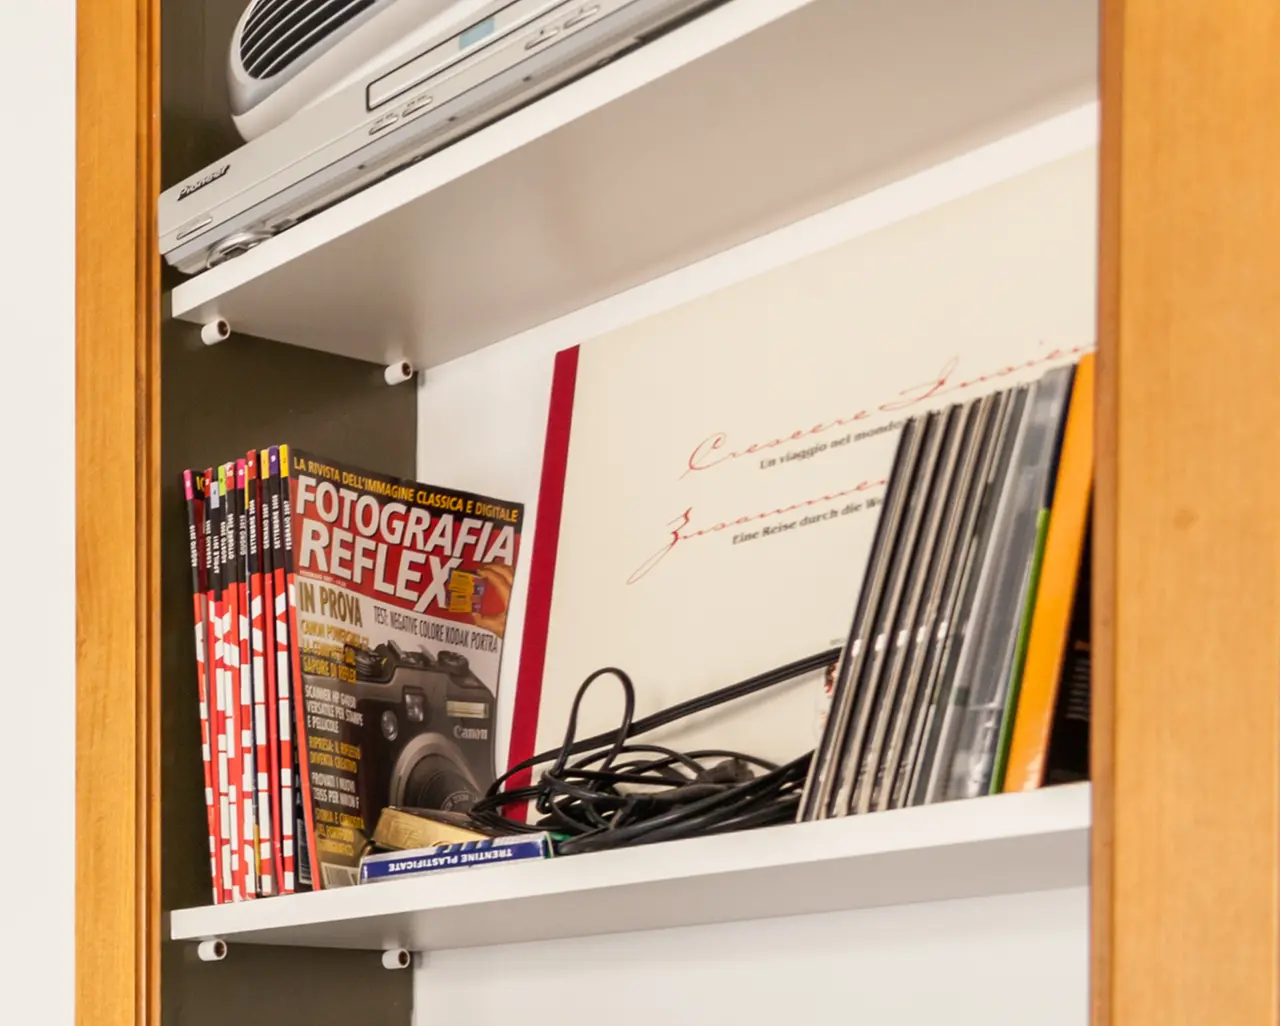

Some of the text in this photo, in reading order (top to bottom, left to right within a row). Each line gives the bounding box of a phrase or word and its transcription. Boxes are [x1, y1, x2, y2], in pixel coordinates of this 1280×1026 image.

[779, 442, 828, 465] viaggio
[830, 433, 851, 450] nel
[293, 457, 519, 523] LA RIVISTA DELL'IMMAGINE CLASSICA E DIGITALE
[295, 474, 516, 567] FOTOGRAFIA
[762, 519, 797, 539] Reise
[799, 507, 839, 527] durch
[841, 502, 863, 516] die
[298, 518, 464, 614] REFLEX
[299, 581, 363, 628] IN PROVA
[389, 610, 418, 636] NEGATIVE
[419, 619, 445, 643] COLORE
[445, 625, 470, 648] KODAK
[471, 630, 498, 653] PORTRA
[453, 725, 488, 740] Canon
[388, 848, 513, 872] TRENTINE PLASTIFICATE
